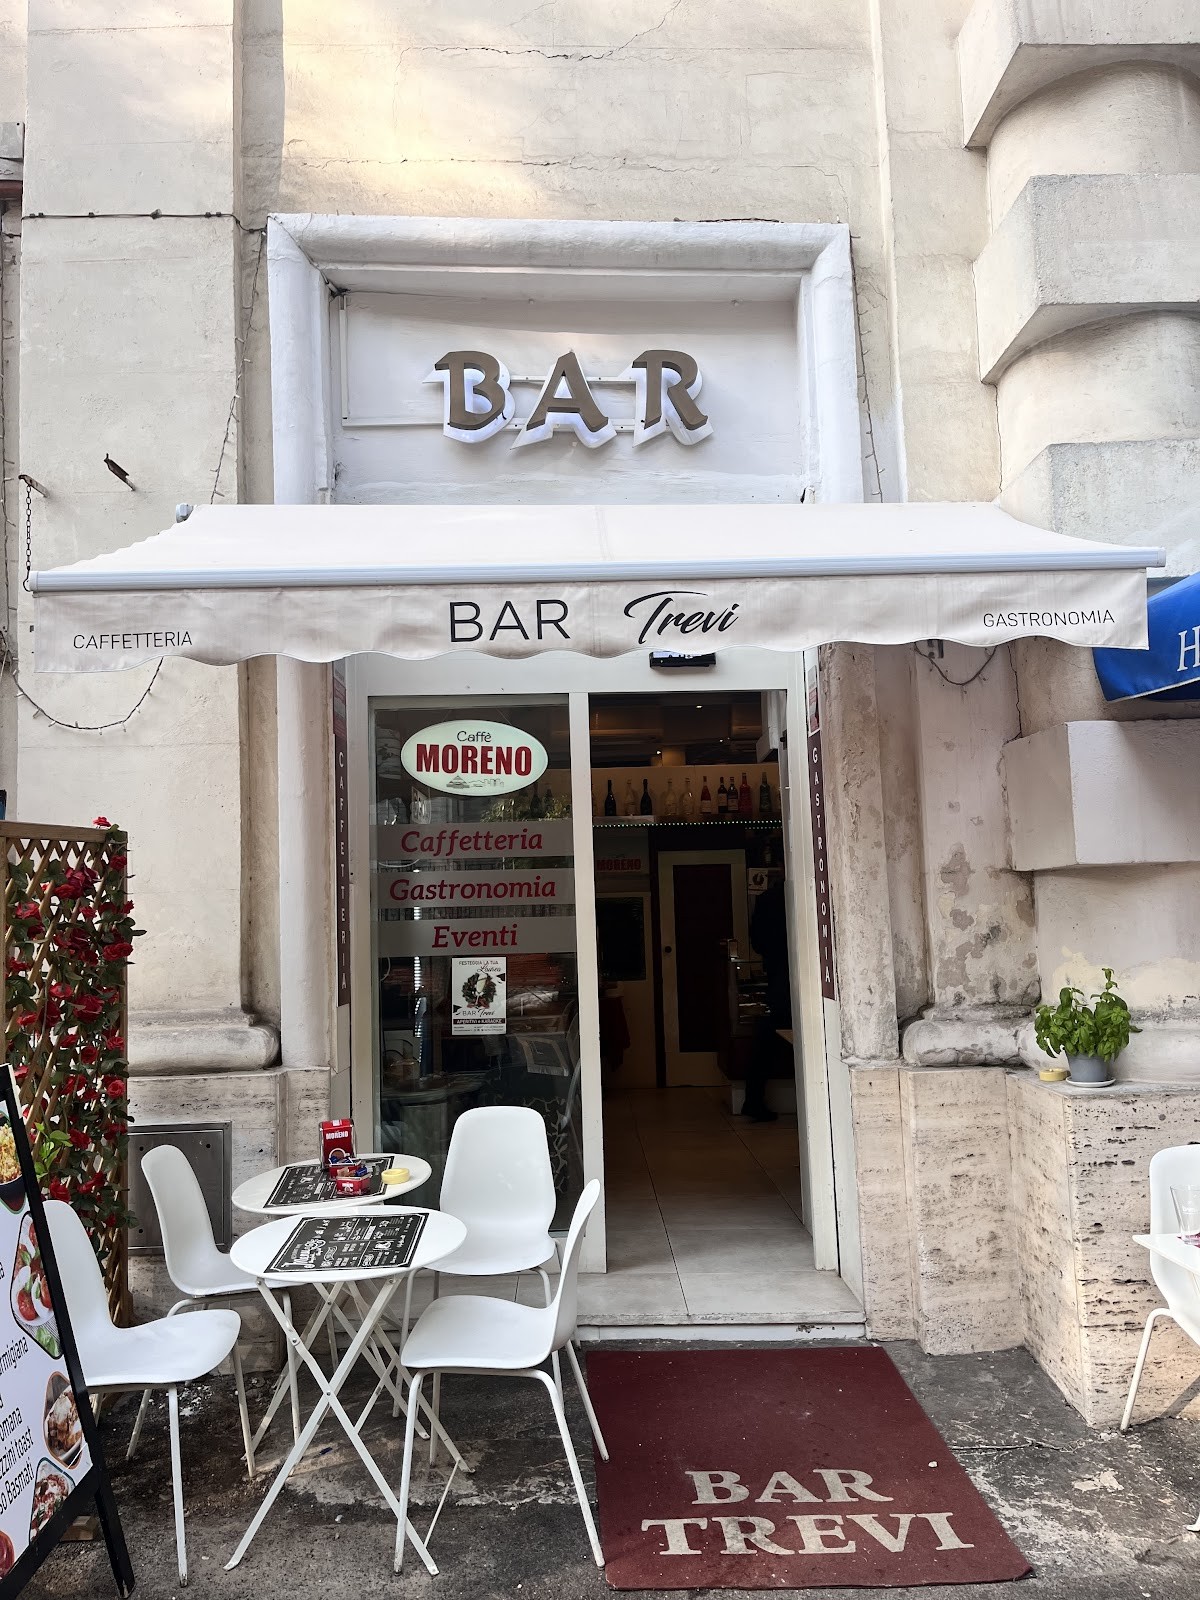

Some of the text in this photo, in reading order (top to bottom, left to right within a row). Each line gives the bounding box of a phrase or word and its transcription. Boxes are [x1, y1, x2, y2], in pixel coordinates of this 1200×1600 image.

[434, 348, 710, 434] BAR
[449, 590, 740, 645] BAR Trevi
[983, 609, 1115, 627] GASTRONOMIA
[73, 631, 193, 649] CAFFETTERIA
[457, 730, 492, 743] Caffè
[416, 743, 532, 777] MORENO
[401, 828, 543, 857] Caffetteria
[337, 751, 347, 990] CAFFETTERIA
[811, 747, 831, 984] GASTRONOMIA
[389, 875, 556, 901] Gastronomia
[432, 924, 518, 949] Eventi
[14, 1425, 34, 1459] toast
[5, 1457, 35, 1505] Basmati
[685, 1469, 894, 1505] BAR
[641, 1512, 975, 1556] TREVI
